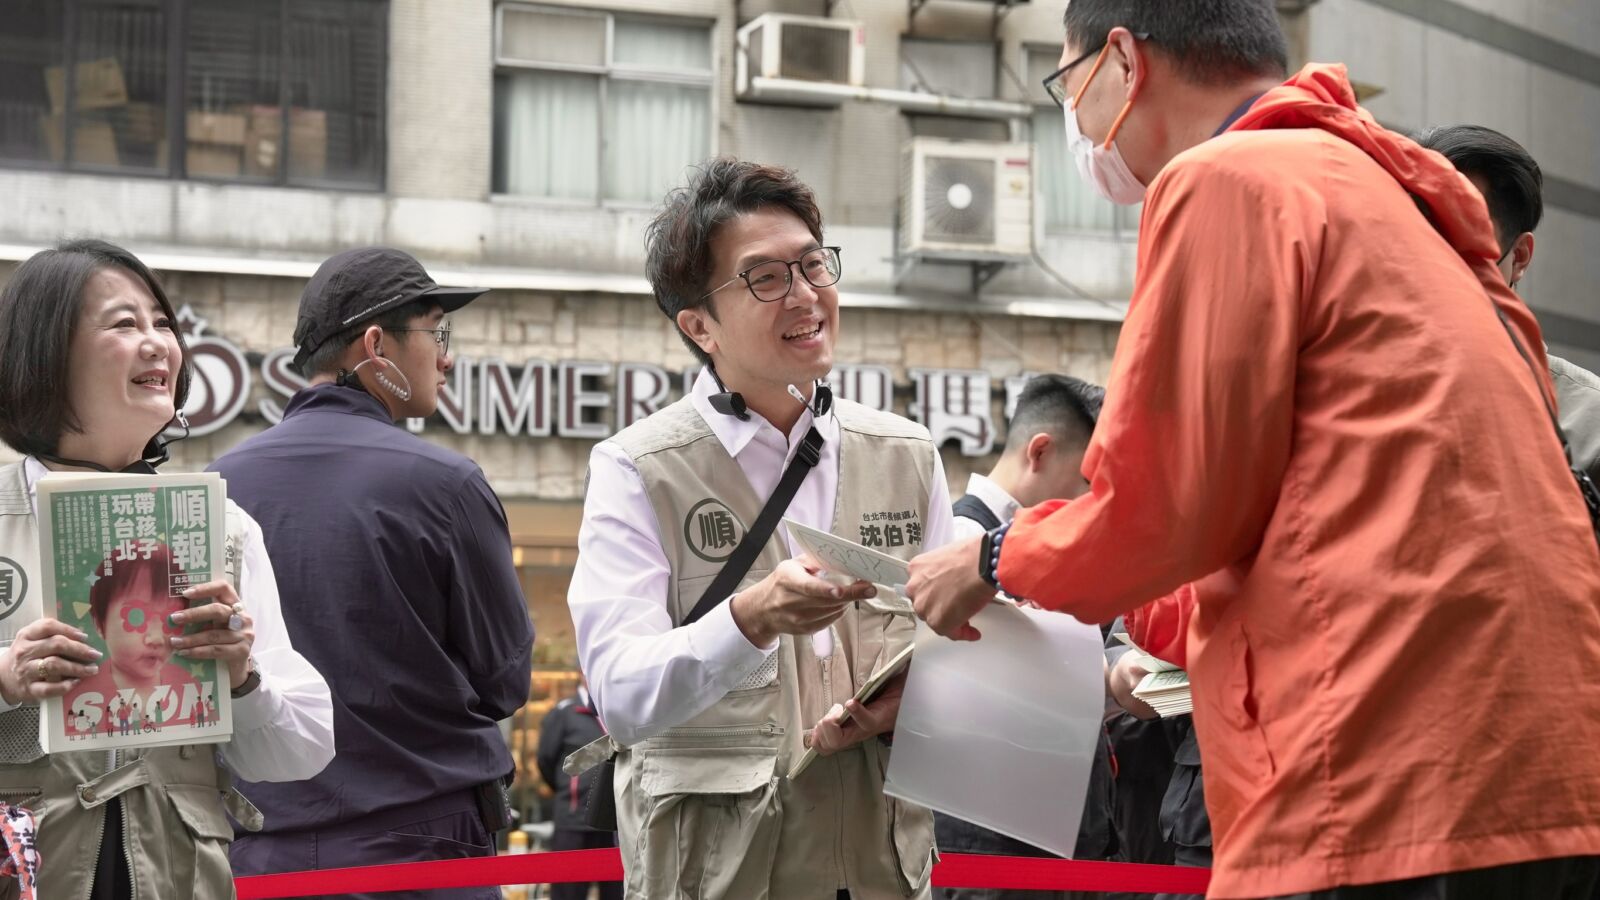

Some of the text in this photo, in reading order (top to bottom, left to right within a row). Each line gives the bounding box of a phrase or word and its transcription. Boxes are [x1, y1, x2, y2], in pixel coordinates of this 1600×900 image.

[111, 494, 137, 562] 玩台北
[134, 492, 159, 560] 帶孩子
[171, 490, 208, 571] 順報
[698, 511, 737, 551] 順
[859, 521, 922, 548] 沈伯洋
[72, 681, 214, 728] SOON
